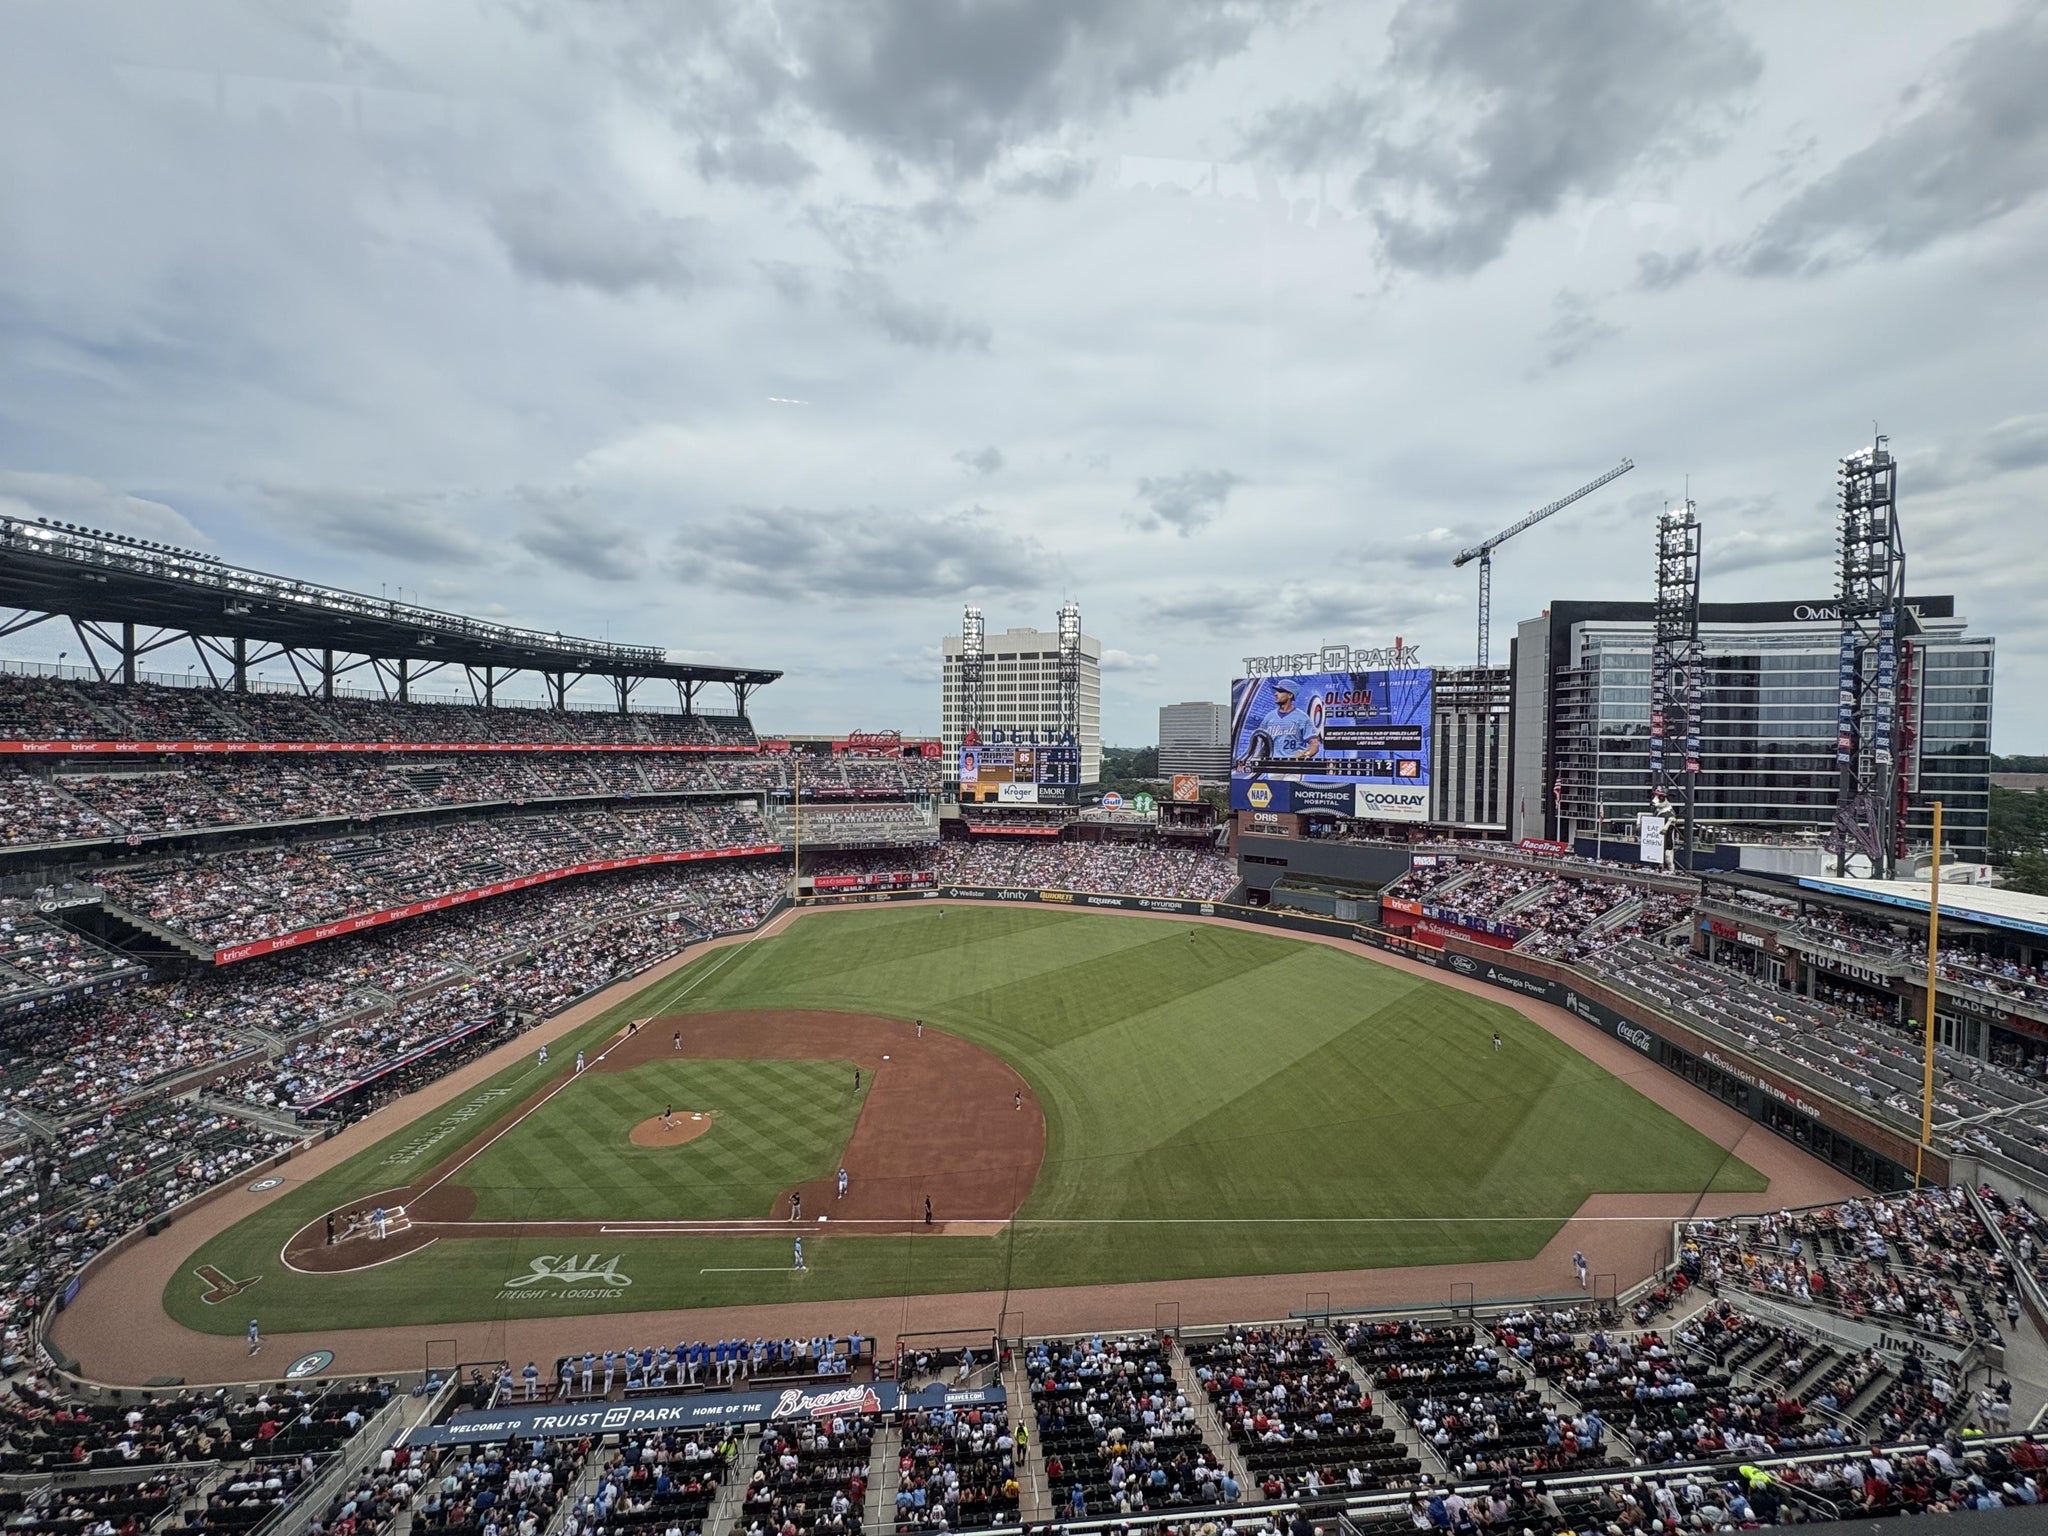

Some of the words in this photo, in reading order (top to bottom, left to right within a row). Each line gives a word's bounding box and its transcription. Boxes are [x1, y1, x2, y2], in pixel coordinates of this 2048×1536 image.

[1243, 653, 1316, 673] TRUIST
[1354, 646, 1420, 668] PARK
[1324, 690, 1372, 705] OLSON
[991, 729, 1077, 746] DELTA
[22, 743, 50, 751] trinet
[71, 743, 97, 751] trinet
[116, 743, 140, 751] trinet
[156, 743, 179, 751] trinet
[1283, 740, 1297, 750] 28
[1020, 753, 1030, 762] 85
[1386, 762, 1392, 770] 2
[1004, 785, 1032, 800] Kroger
[1174, 777, 1198, 800] HOME
[1251, 790, 1268, 800] NAPA
[1294, 791, 1350, 800] NORTHSIDE
[1365, 794, 1424, 806] COOLRAY
[1254, 812, 1278, 822] ORIS
[1522, 840, 1562, 853] RaceTrac
[998, 890, 1028, 900] xfinity
[1040, 892, 1074, 900] QUIKRETE
[1088, 896, 1124, 905] EQUIFAX
[58, 896, 102, 908] LEXUS
[1391, 900, 1413, 912] trinet
[390, 908, 410, 918] trinet
[354, 916, 376, 928] trinet
[316, 925, 340, 938] trinet
[272, 936, 298, 948] trinet
[1737, 931, 1765, 948] LIGHT
[223, 947, 252, 961] trinet
[1454, 956, 1472, 970] Ford
[1800, 951, 1834, 971] CHOP
[1840, 962, 1891, 988] HOUSE
[1497, 973, 1523, 989] Georgia
[1524, 979, 1546, 995] Power
[84, 987, 93, 995] 68
[1952, 997, 1988, 1015] MADE
[1710, 1052, 1734, 1073] Coors
[1733, 1067, 1756, 1085] LIGHT
[1759, 1078, 1787, 1100] BELOW
[1796, 1099, 1820, 1118] CHOP
[495, 1289, 549, 1299] FREIGHT
[559, 1288, 625, 1299] LOGISTICS
[1872, 1333, 1908, 1351] JIM
[946, 1392, 984, 1402] BRAVES.COM
[449, 1422, 505, 1434] WELCOME
[508, 1420, 522, 1429] TO
[532, 1412, 602, 1429] TRUIST
[632, 1407, 684, 1422] PARK
[692, 1406, 724, 1416] HOME
[726, 1405, 740, 1414] OF
[742, 1404, 762, 1412] THE
[771, 1384, 864, 1420] Braves
